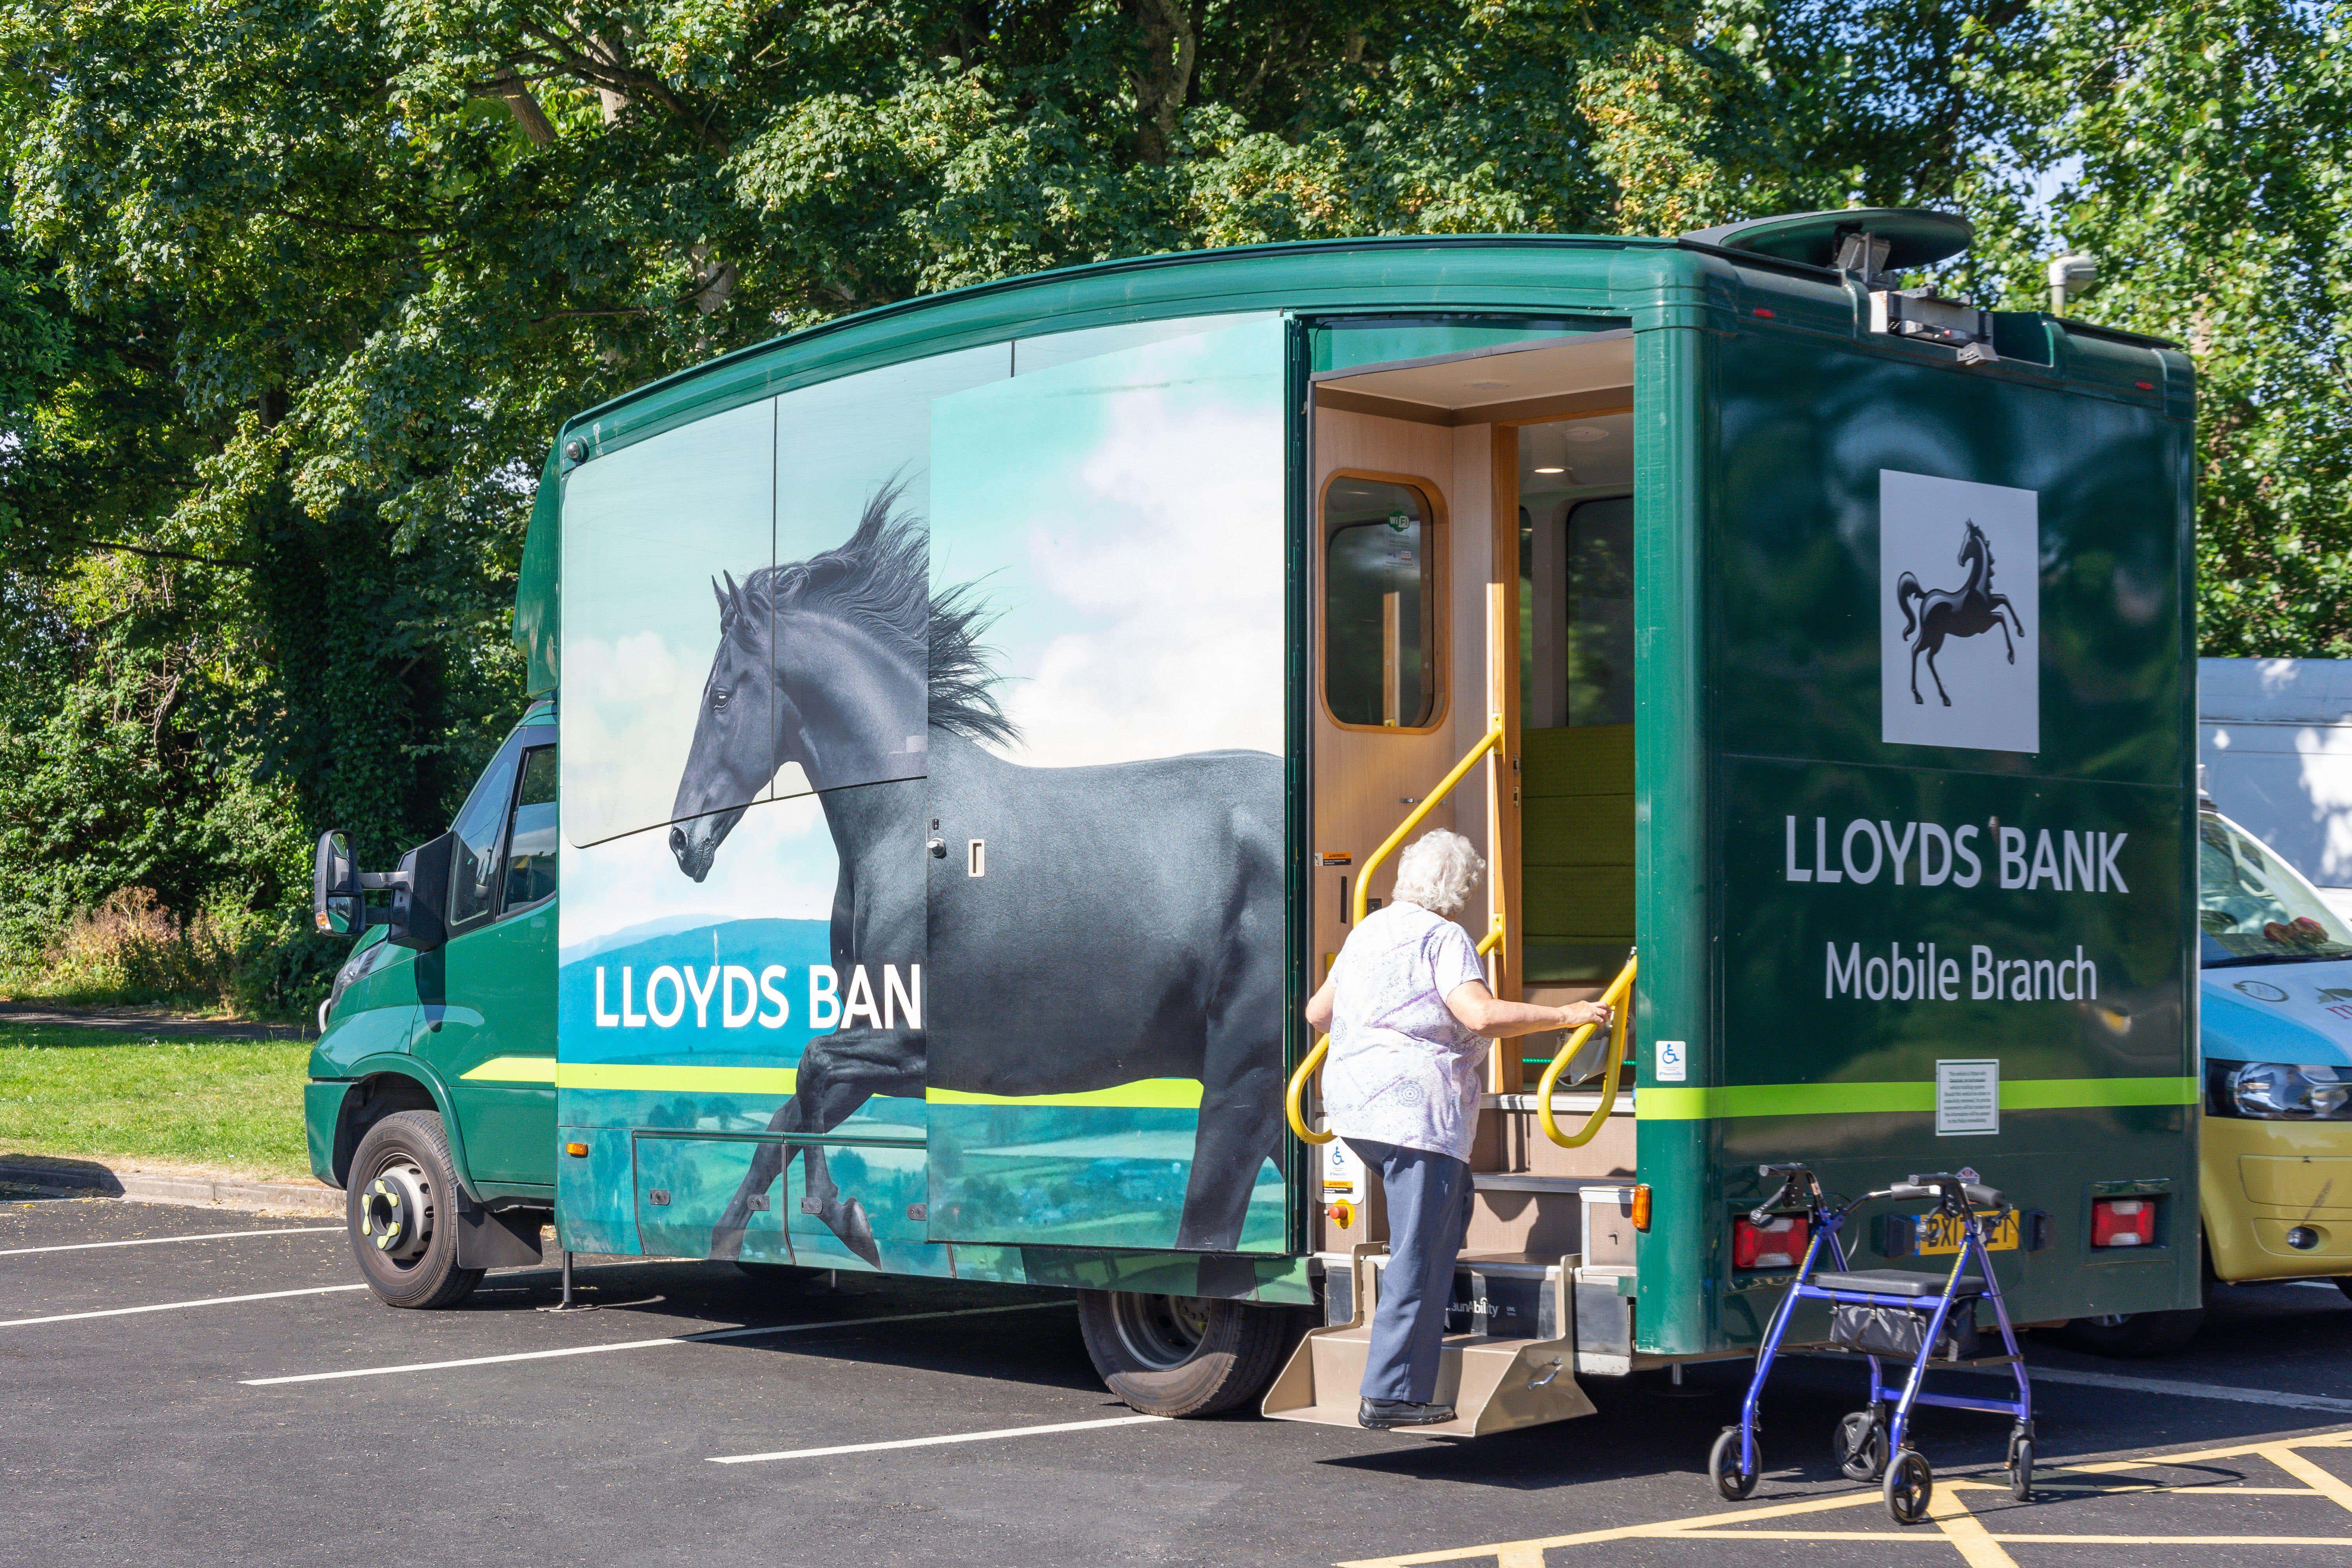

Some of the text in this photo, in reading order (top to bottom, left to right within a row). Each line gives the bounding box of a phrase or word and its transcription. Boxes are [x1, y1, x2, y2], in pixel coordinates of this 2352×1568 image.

[1786, 815, 2129, 893] LLOYDS BANK
[596, 964, 921, 1029] LLOYDS BAN
[1826, 942, 2097, 1001] Mobile Branch
